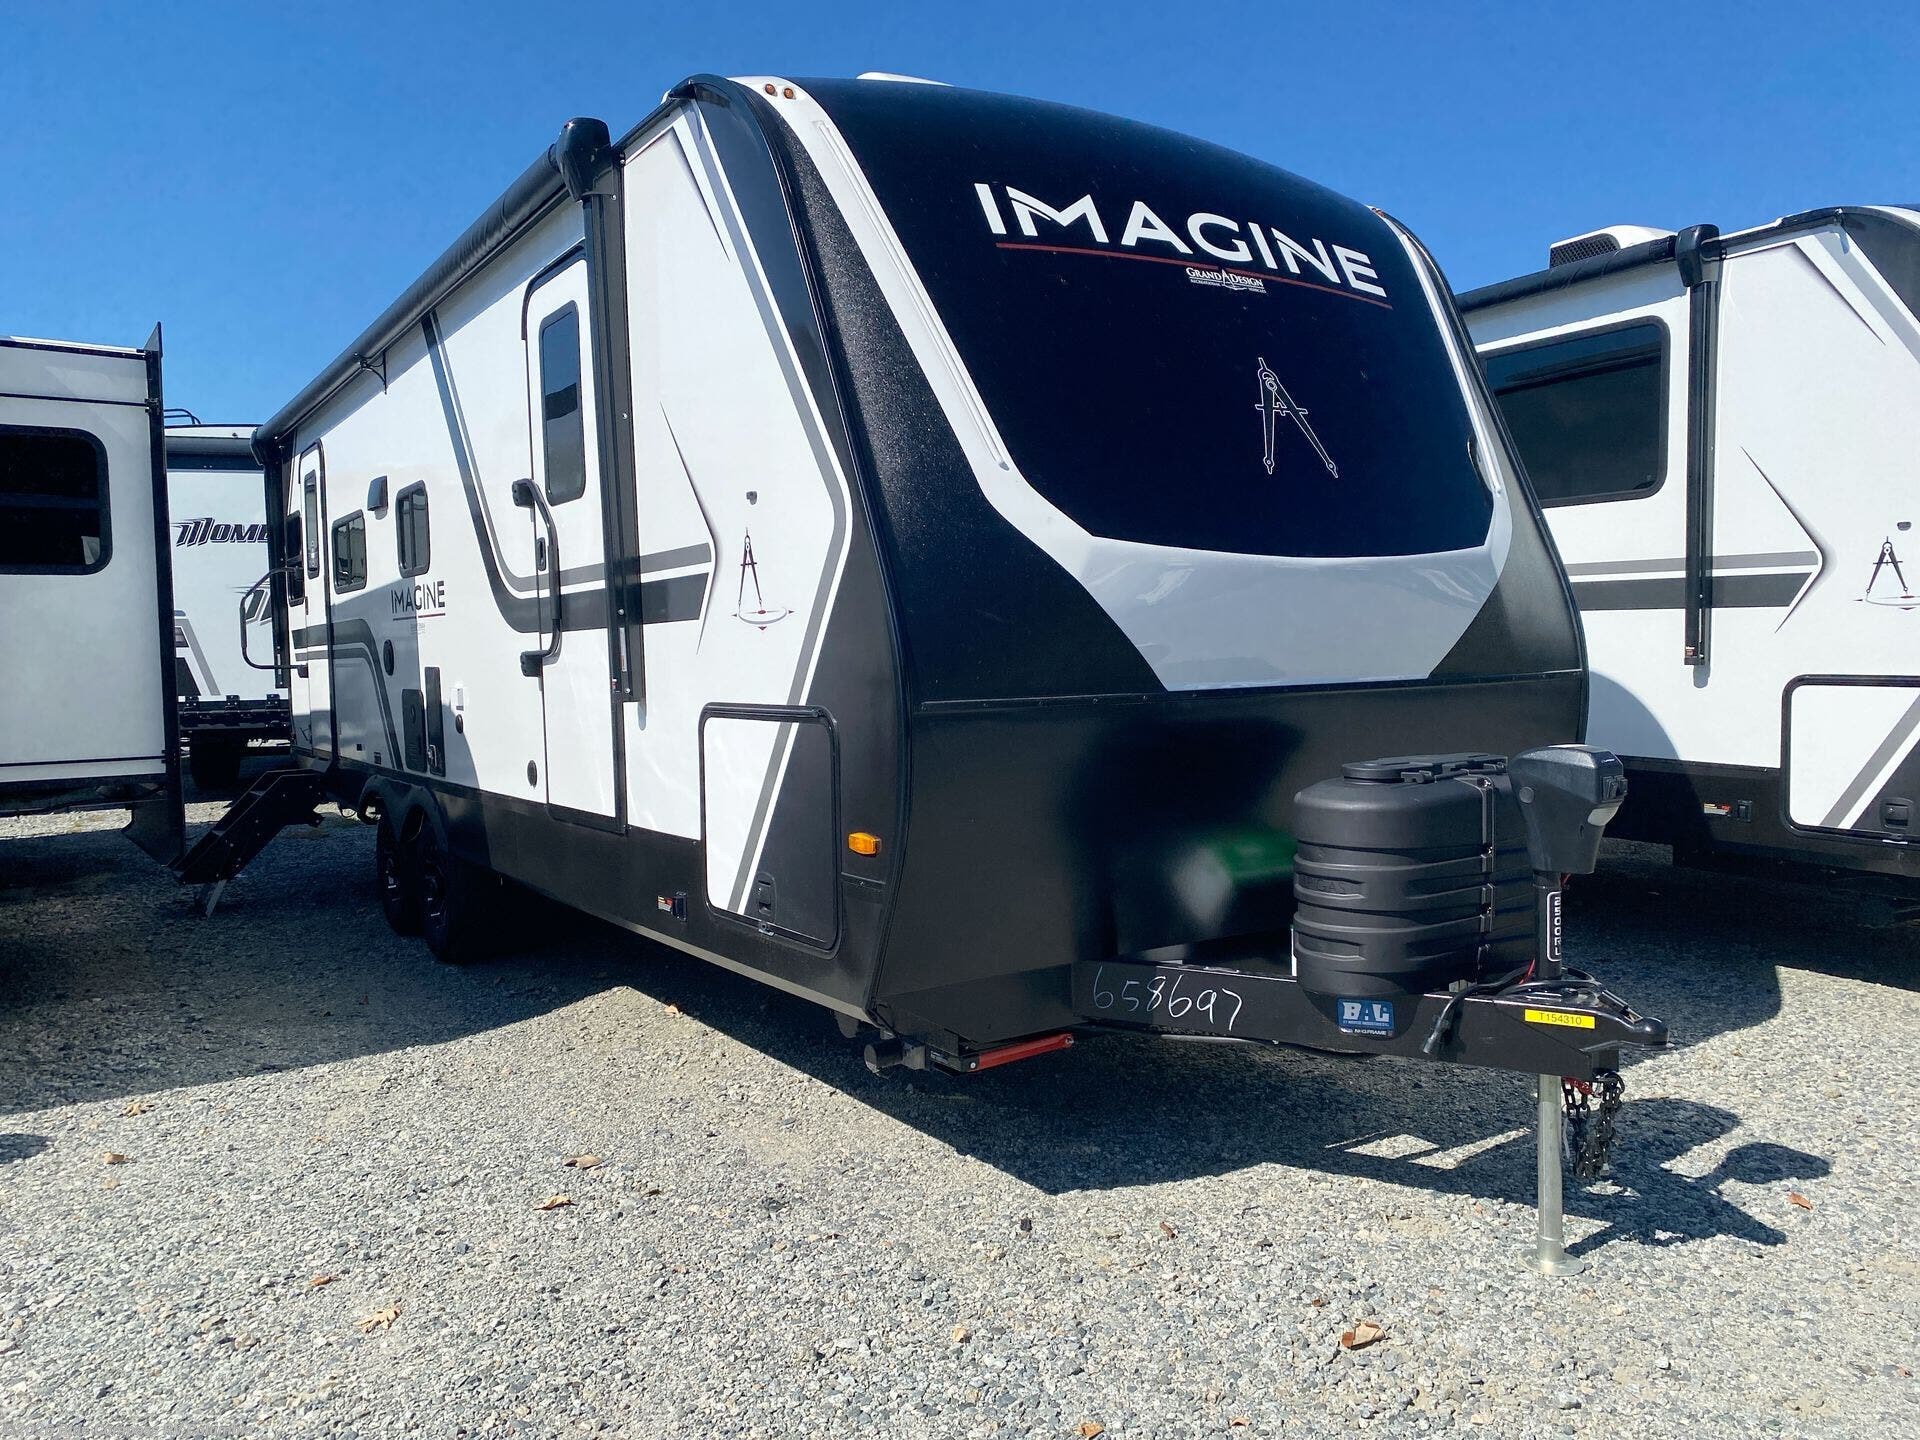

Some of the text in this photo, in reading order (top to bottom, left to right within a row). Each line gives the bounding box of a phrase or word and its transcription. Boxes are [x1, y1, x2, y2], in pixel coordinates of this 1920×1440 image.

[974, 183, 1387, 298] IMAGINE
[1185, 267, 1222, 281] GRAND
[1229, 273, 1264, 287] DESIGN
[391, 581, 446, 614] IMAGINE
[1094, 966, 1242, 1031] 658697
[1540, 1012, 1582, 1026] T154310
